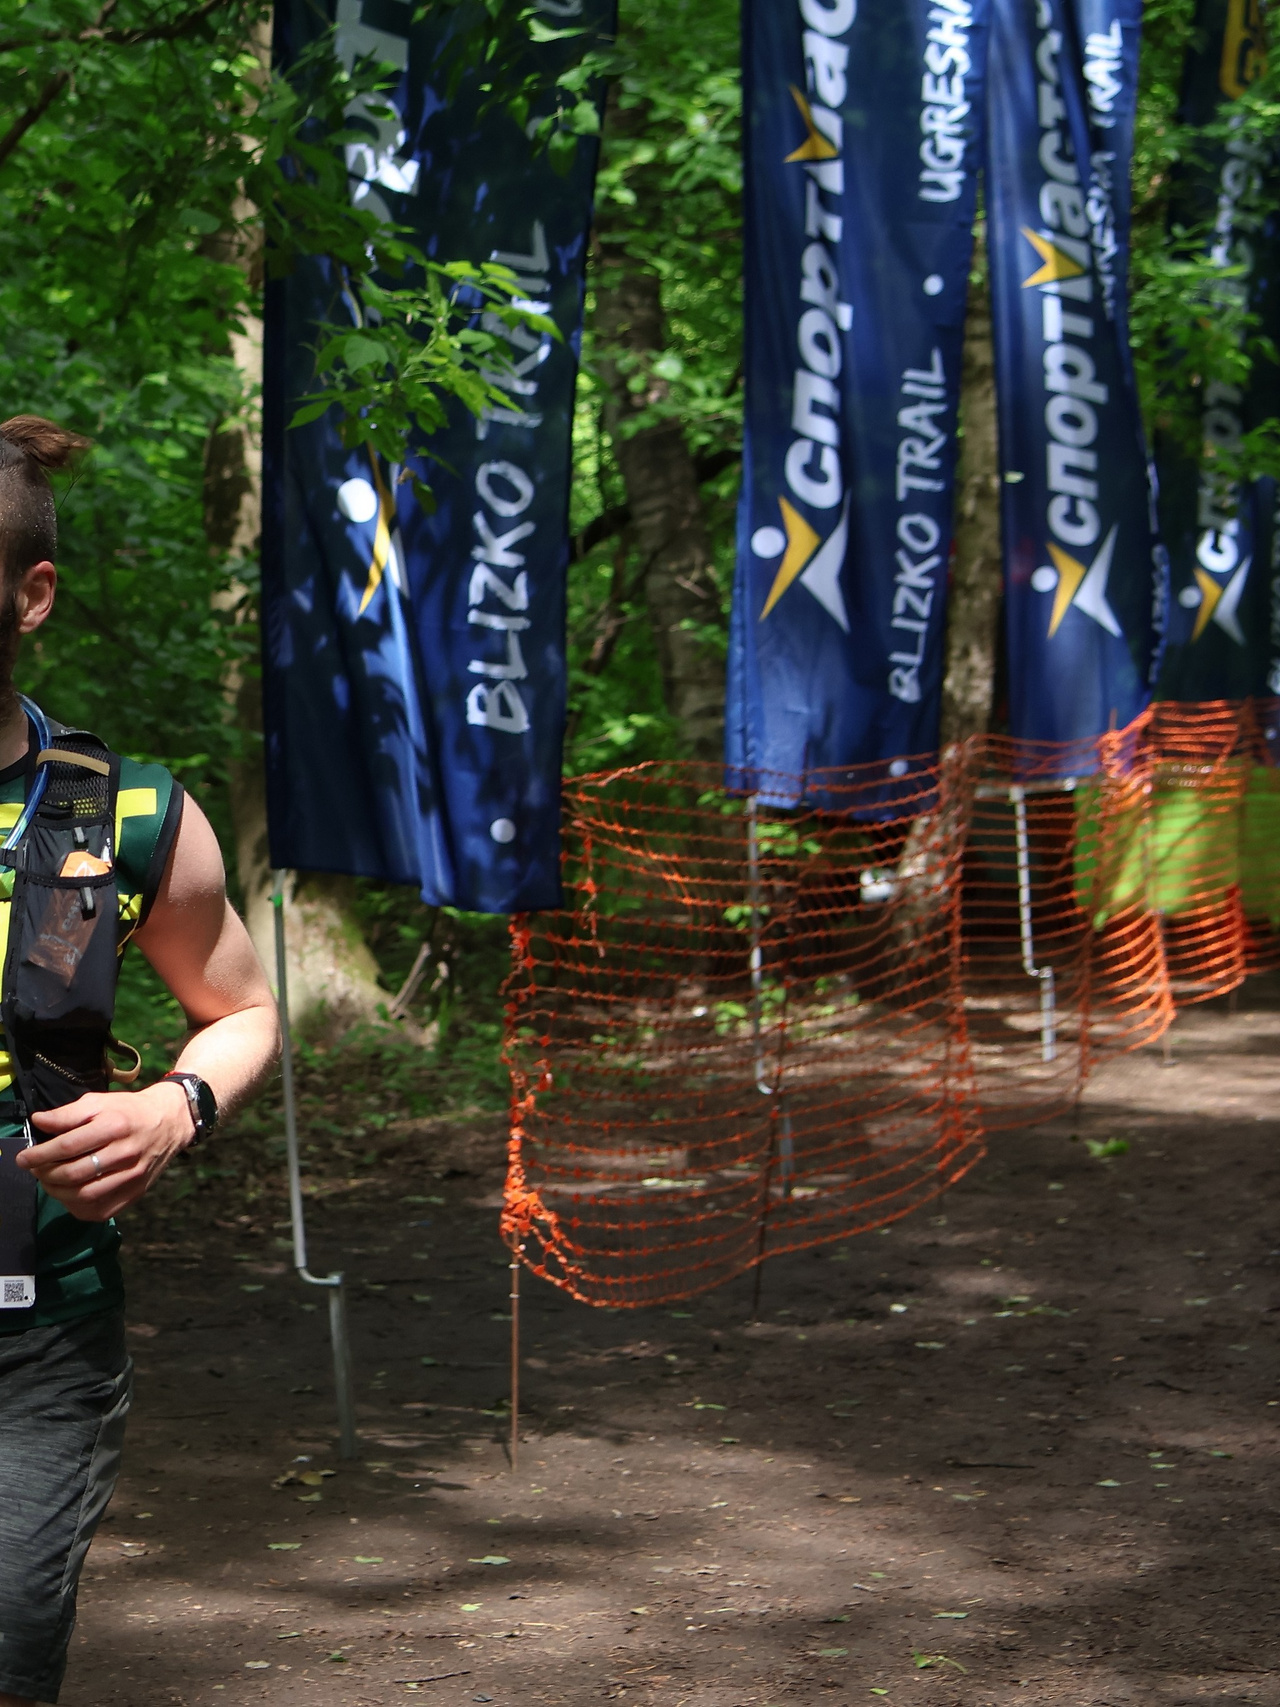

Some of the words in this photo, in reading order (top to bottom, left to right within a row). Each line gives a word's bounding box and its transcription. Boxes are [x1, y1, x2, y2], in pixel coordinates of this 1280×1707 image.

[895, 347, 948, 502] TRAIL
[466, 458, 540, 735] BLIZKO
[887, 512, 941, 704] BLIZKO
